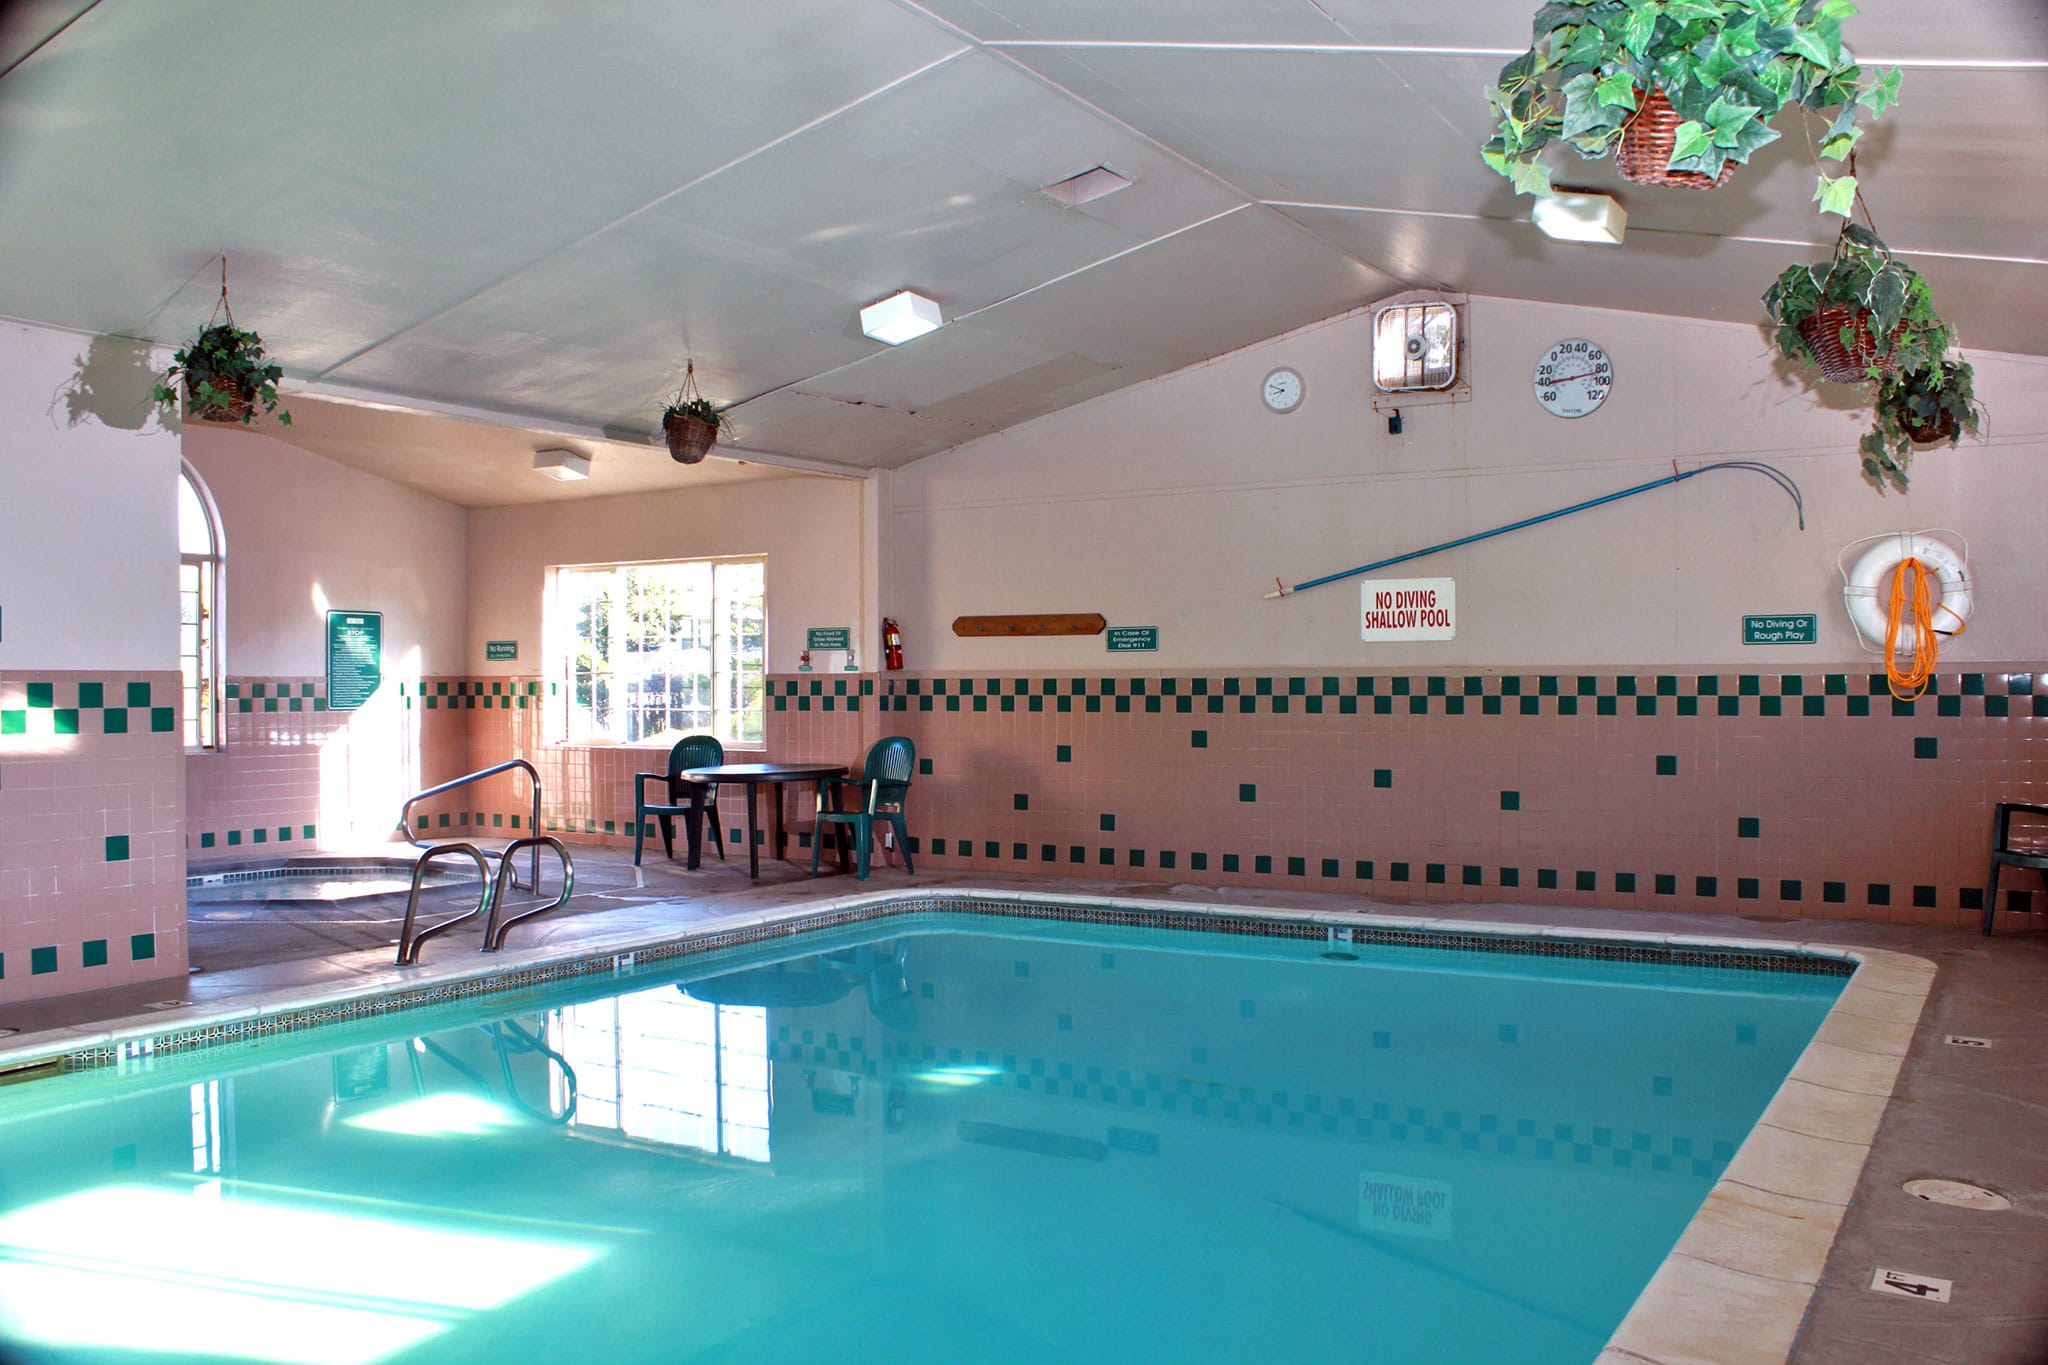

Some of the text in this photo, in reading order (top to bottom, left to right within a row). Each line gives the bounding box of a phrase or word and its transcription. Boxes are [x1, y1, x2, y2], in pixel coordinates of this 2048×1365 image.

[1560, 344, 1573, 354] 20
[1575, 343, 1588, 353] 40
[1551, 352, 1558, 361] 0
[1588, 351, 1602, 360] 60
[1536, 365, 1553, 375] -20
[1595, 363, 1608, 373] 80
[1594, 376, 1611, 386] 100
[1587, 390, 1605, 400] 120
[1375, 590, 1437, 609] NO DIVING
[1365, 609, 1451, 629] SHALLOW POOL
[1751, 619, 1808, 629] No Diving Or
[1754, 631, 1805, 641] Rough Play
[1884, 1279, 1940, 1297] 4
